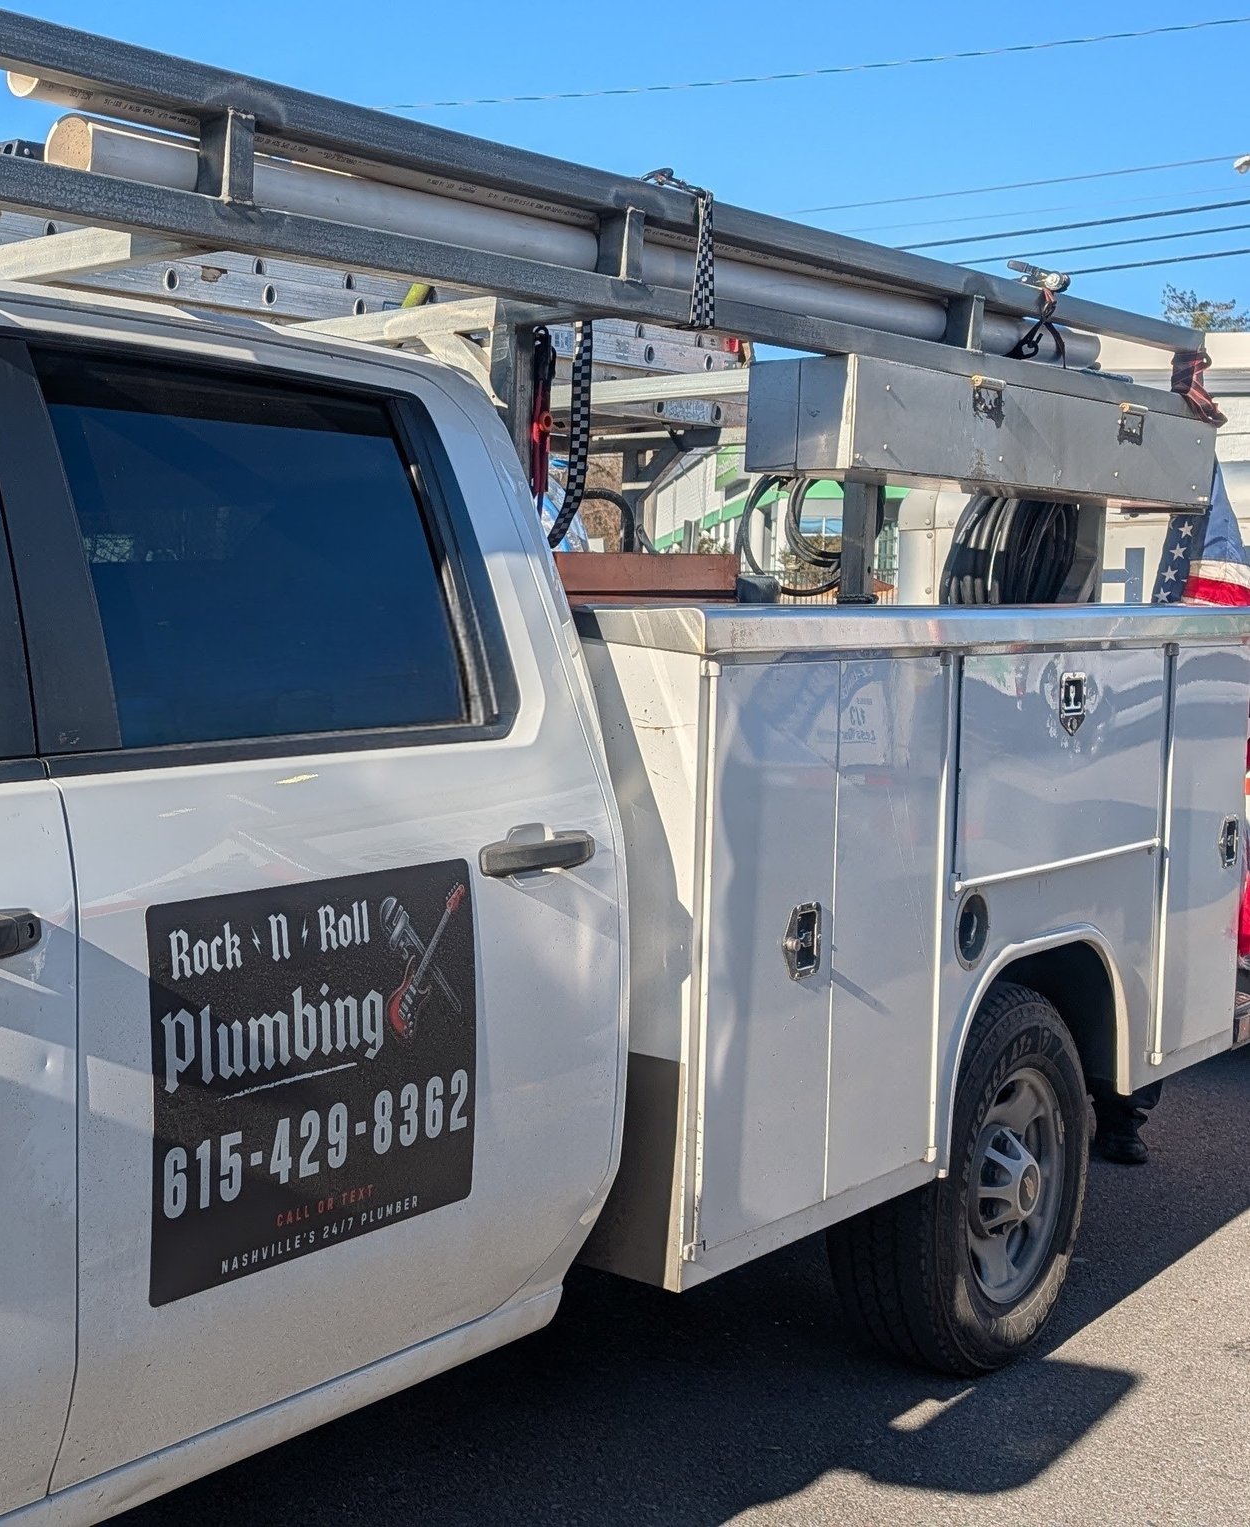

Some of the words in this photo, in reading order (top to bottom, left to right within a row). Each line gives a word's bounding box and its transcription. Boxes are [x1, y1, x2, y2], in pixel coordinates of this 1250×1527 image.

[168, 921, 243, 981] Rock
[317, 900, 370, 952] Roll
[161, 983, 384, 1093] Plumbing
[163, 1069, 468, 1220] 615-429-8362
[221, 1230, 316, 1274] NASHVILLE'S
[322, 1218, 353, 1239] 24/7
[360, 1195, 419, 1226] PLUMBER
[276, 1206, 310, 1227] CALL
[317, 1197, 335, 1214] OR
[342, 1183, 374, 1206] TEXT
